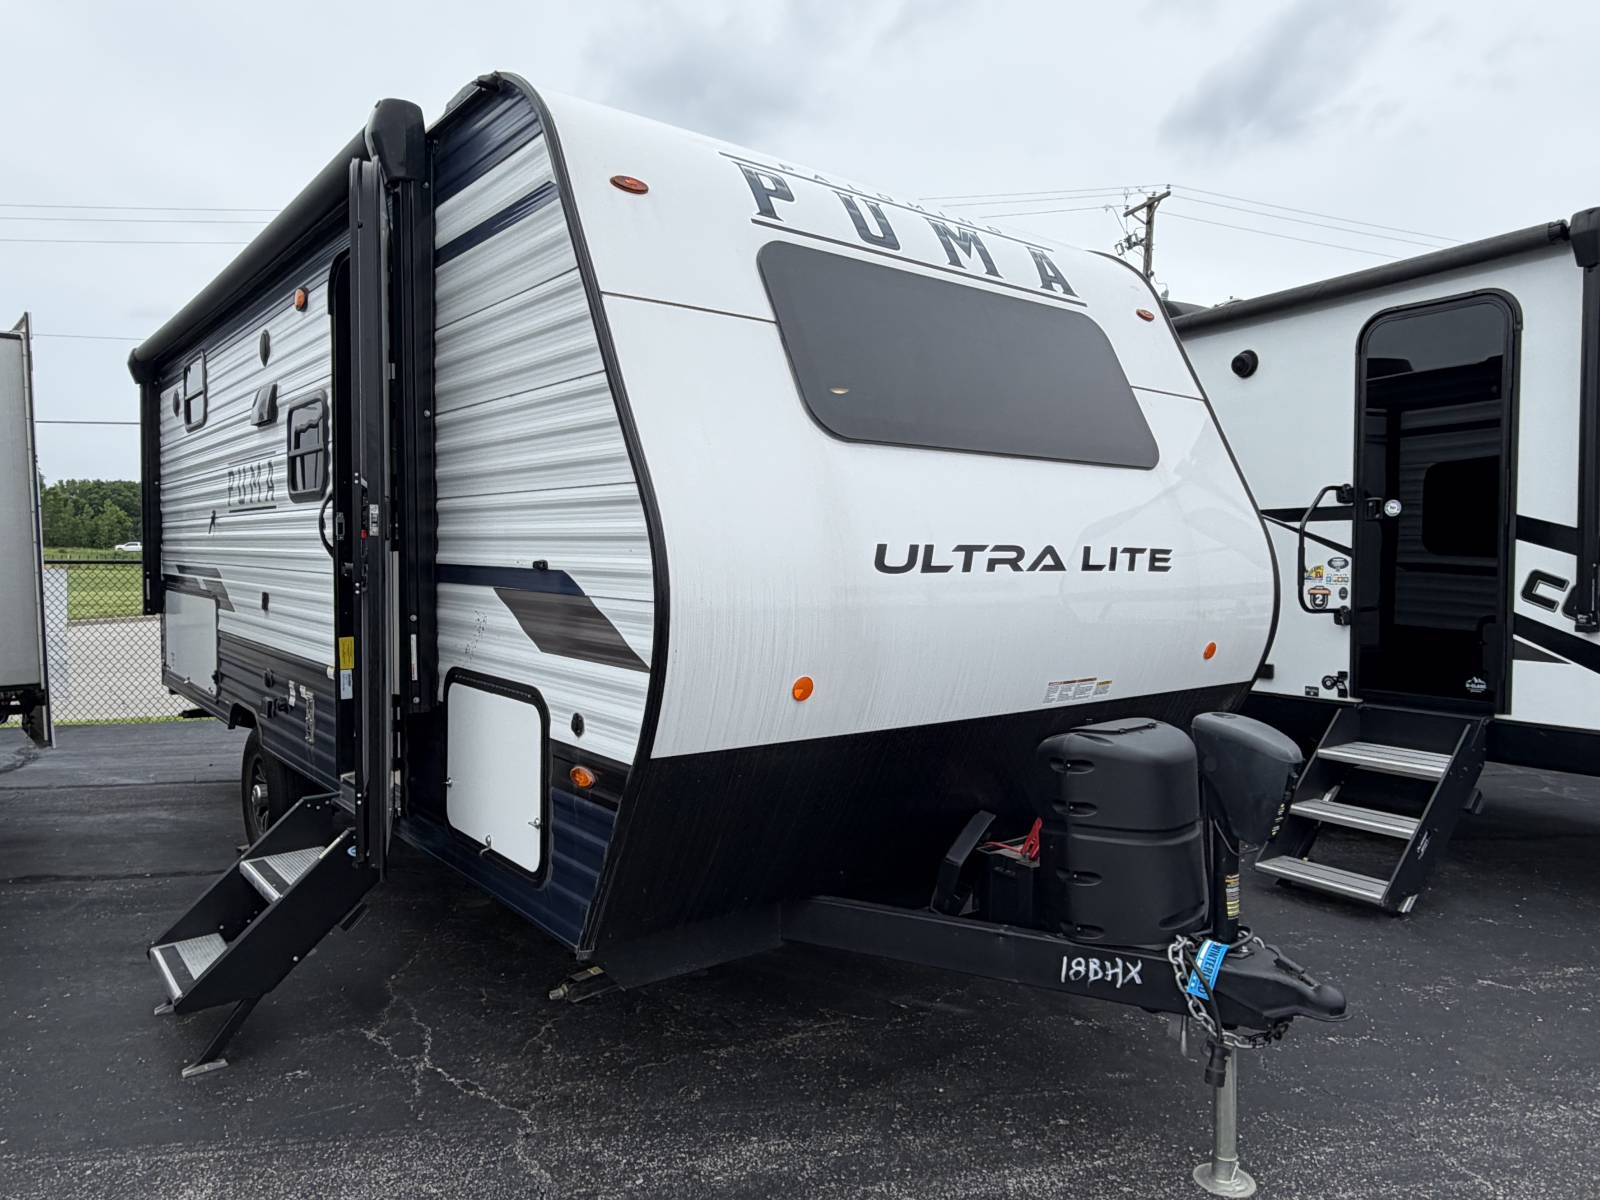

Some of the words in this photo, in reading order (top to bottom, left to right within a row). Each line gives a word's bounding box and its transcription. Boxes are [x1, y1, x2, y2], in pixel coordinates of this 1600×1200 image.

[733, 161, 1080, 298] PUMA
[228, 461, 275, 506] PUMA
[873, 543, 1068, 574] ULTRA
[1080, 545, 1173, 573] LITE
[1061, 955, 1143, 989] 18BHX
